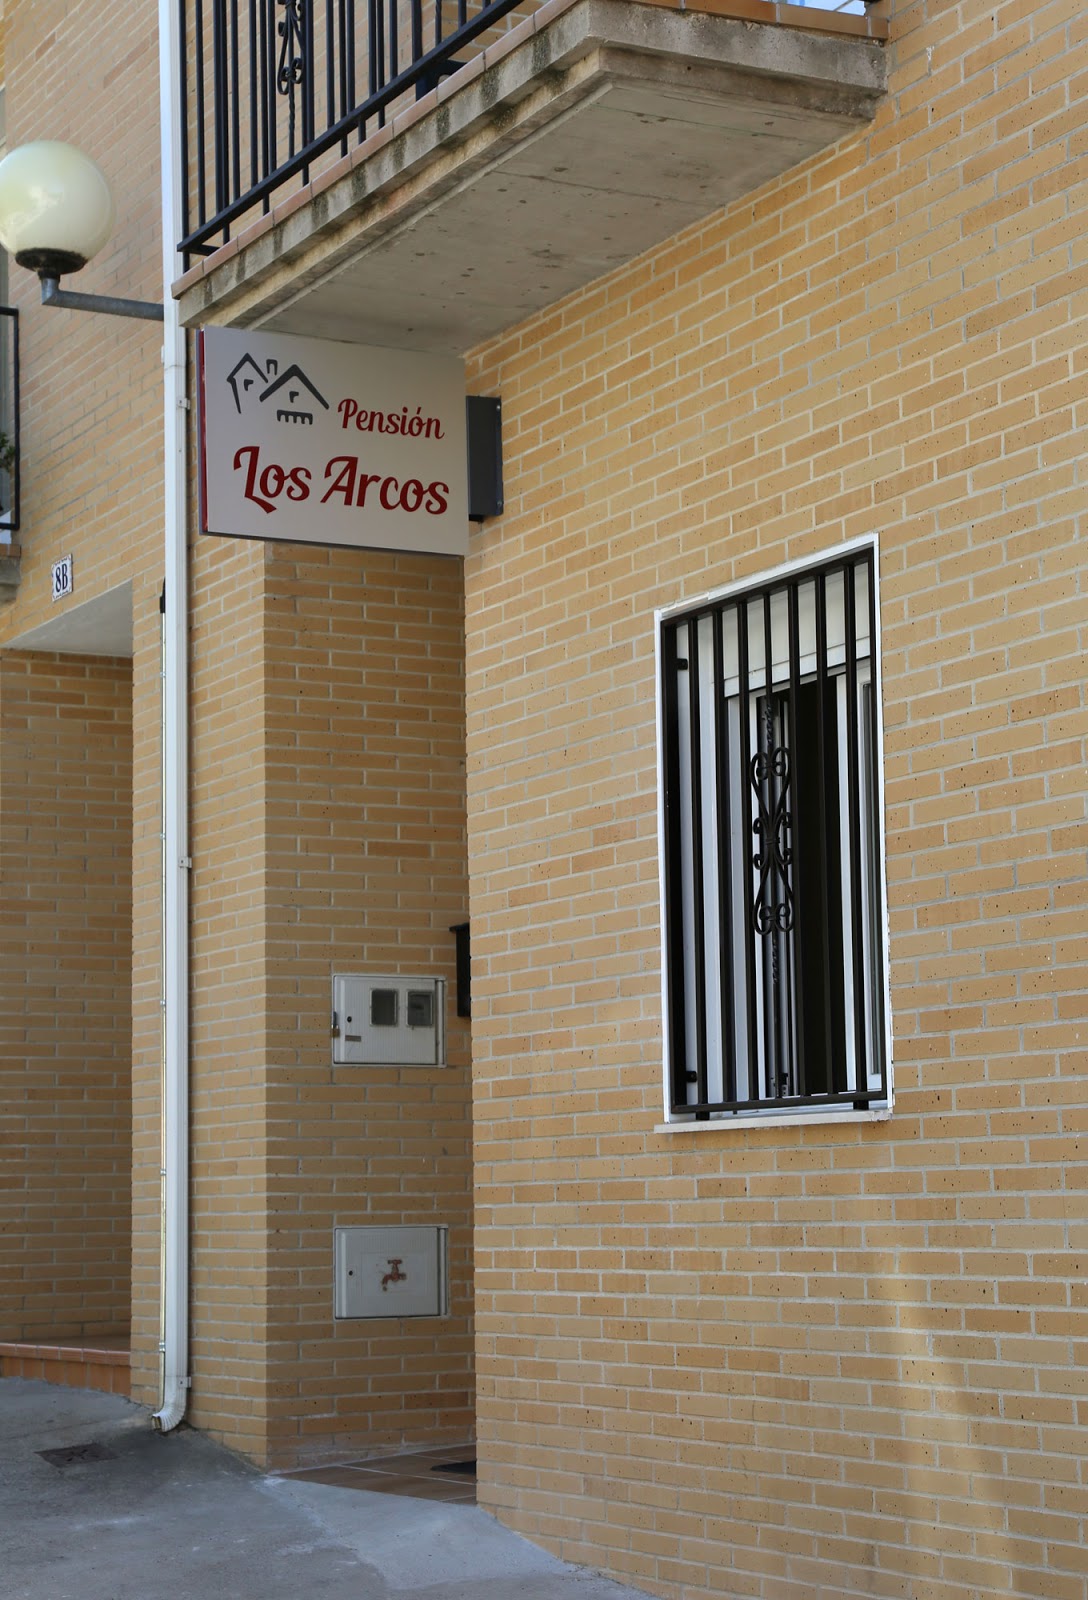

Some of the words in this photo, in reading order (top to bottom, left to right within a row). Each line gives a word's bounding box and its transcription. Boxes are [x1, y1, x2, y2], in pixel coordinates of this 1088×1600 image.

[337, 398, 445, 440] Pensión
[233, 445, 312, 514] Los
[320, 455, 450, 515] Arcos
[55, 563, 69, 593] 8B
